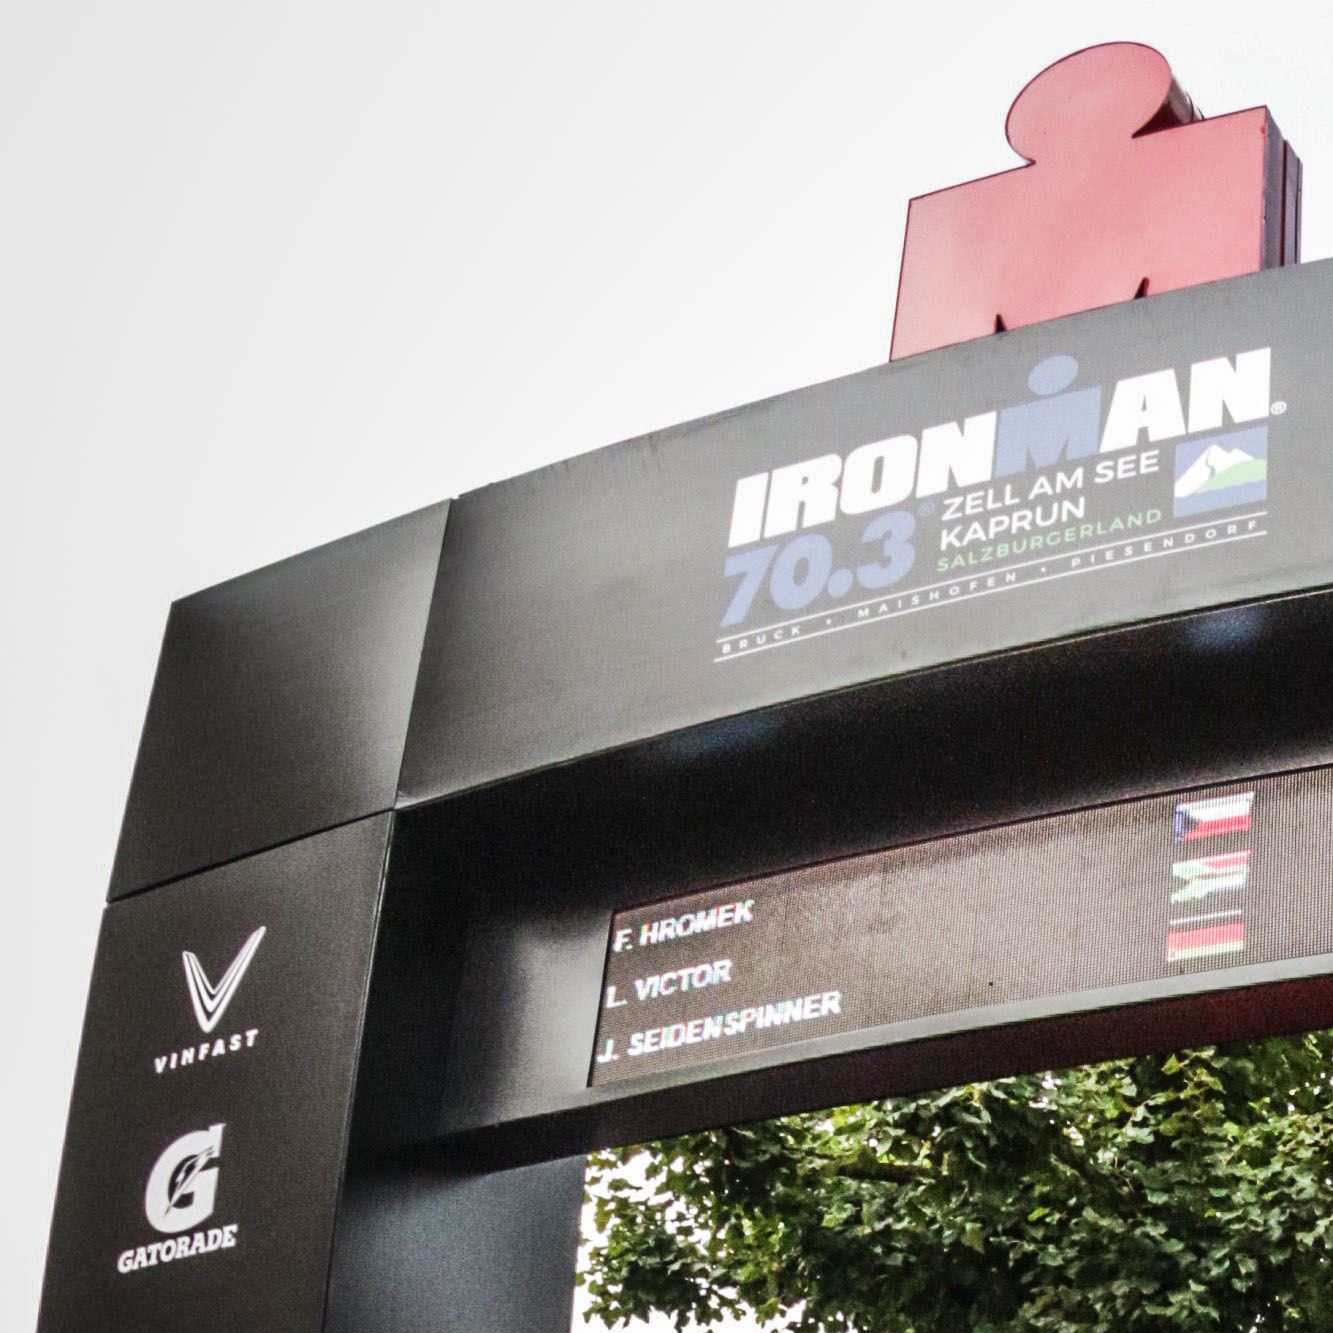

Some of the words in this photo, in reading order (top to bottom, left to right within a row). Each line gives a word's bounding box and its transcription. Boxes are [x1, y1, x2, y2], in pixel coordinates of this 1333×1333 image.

[728, 347, 1271, 548] IRONMAN
[941, 483, 1020, 522] ZELL
[1028, 468, 1084, 500] AM
[1094, 449, 1160, 484] SEE
[936, 508, 1163, 573] SALZBURGERLAND
[940, 496, 1086, 551] KAPRUN
[720, 510, 916, 628] 70.3
[721, 625, 802, 655] BRUCK
[857, 571, 1017, 619] MAISHOFEN
[1071, 519, 1258, 568] PIESENDORF
[613, 928, 632, 952] F.
[639, 899, 755, 946] HROMEK
[606, 985, 627, 1009] L.
[634, 958, 732, 1001] VICTOR
[154, 1029, 260, 1073] VINFAST
[597, 1039, 619, 1063] J.
[627, 991, 842, 1056] SEIDENSPINNER
[117, 1224, 238, 1273] GATORADE
